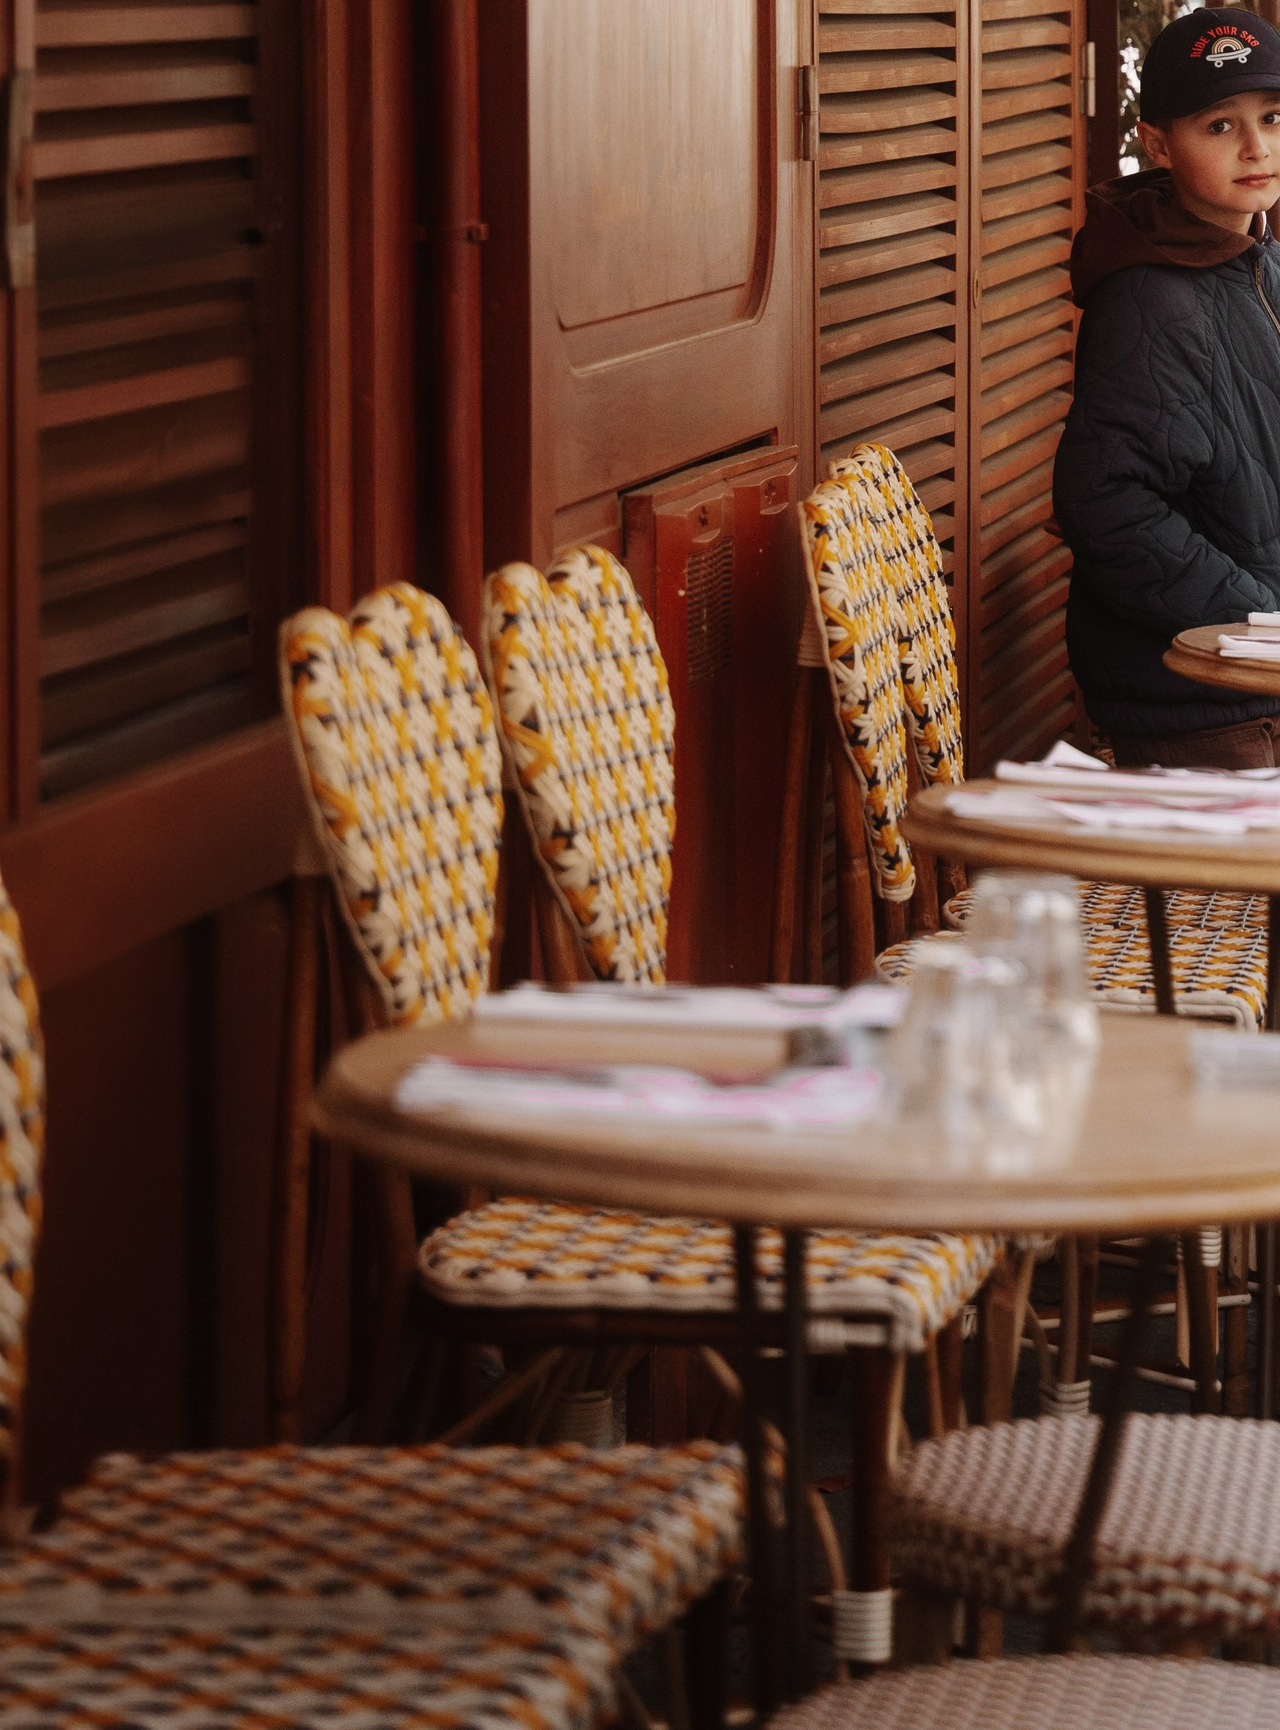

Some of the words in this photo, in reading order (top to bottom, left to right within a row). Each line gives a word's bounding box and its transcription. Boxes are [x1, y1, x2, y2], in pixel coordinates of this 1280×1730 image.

[1190, 36, 1210, 58] RIDE
[1207, 26, 1238, 38] YOUR
[1240, 30, 1260, 47] SK8
